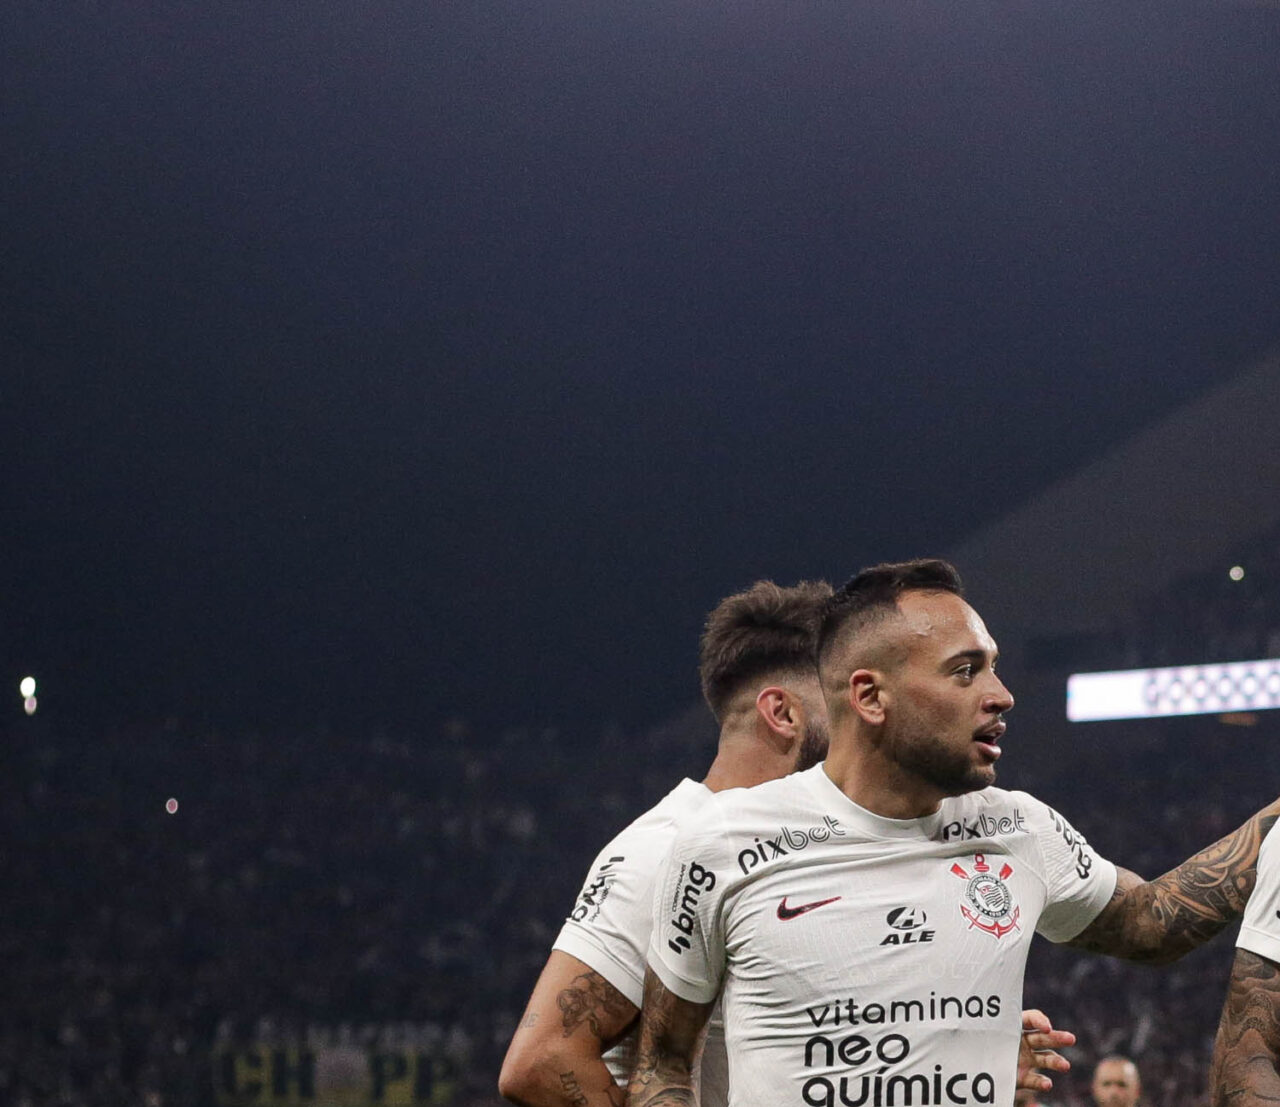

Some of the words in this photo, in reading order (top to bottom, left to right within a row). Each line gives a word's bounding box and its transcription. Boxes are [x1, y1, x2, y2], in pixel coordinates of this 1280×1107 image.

[943, 808, 1030, 841] pixbet
[738, 815, 846, 876] pixbet
[671, 861, 716, 935] bmg
[879, 930, 936, 946] ALE
[806, 991, 1001, 1028] vitaminas
[804, 1034, 910, 1067] neo
